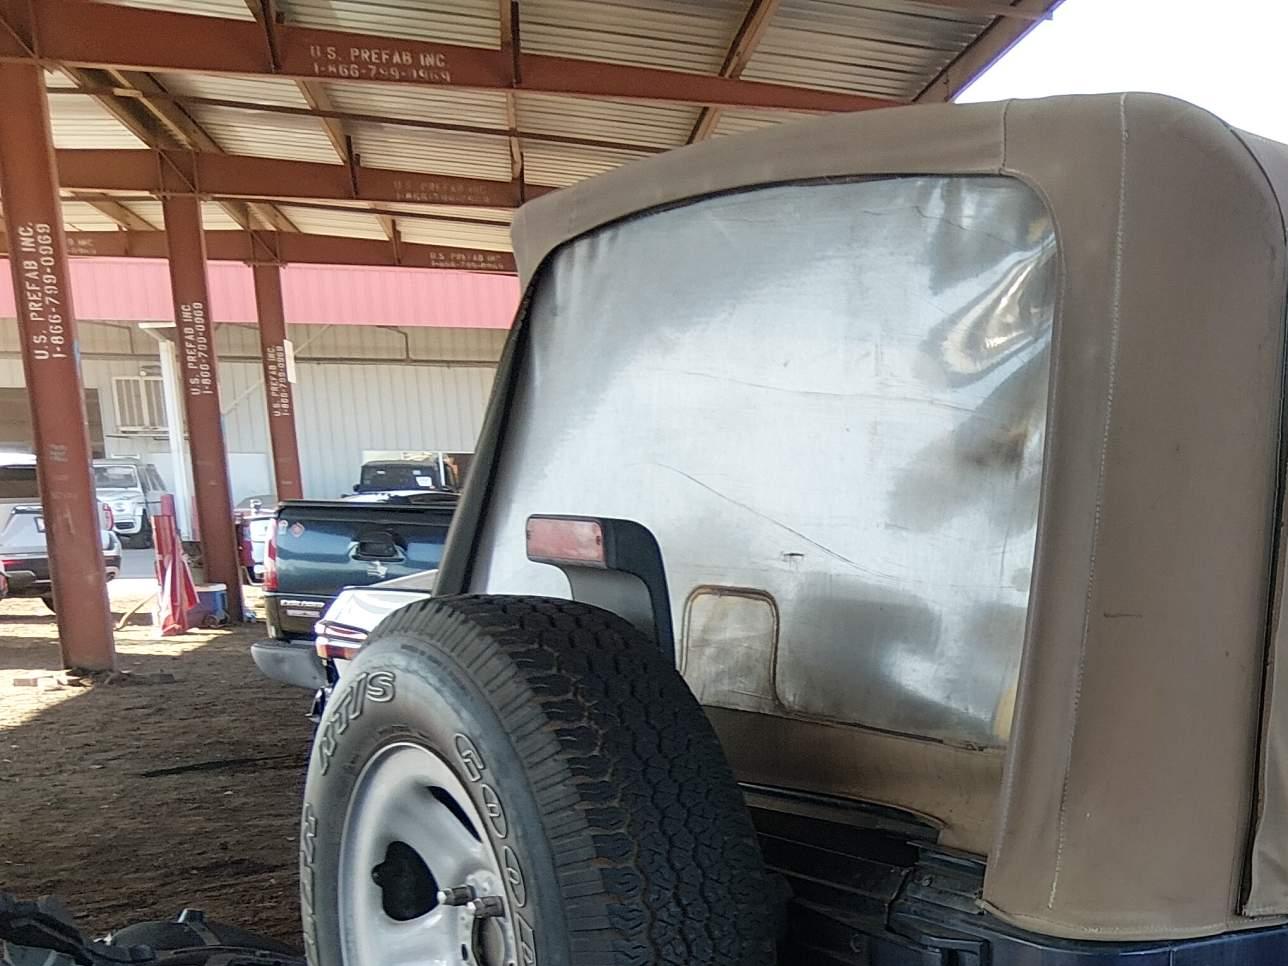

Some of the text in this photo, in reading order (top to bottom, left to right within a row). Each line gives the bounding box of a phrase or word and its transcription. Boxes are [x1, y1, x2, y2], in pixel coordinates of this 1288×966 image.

[350, 48, 413, 65] PREFAB
[23, 260, 45, 321] PREFAB
[36, 223, 68, 358] 1-866-799-0969
